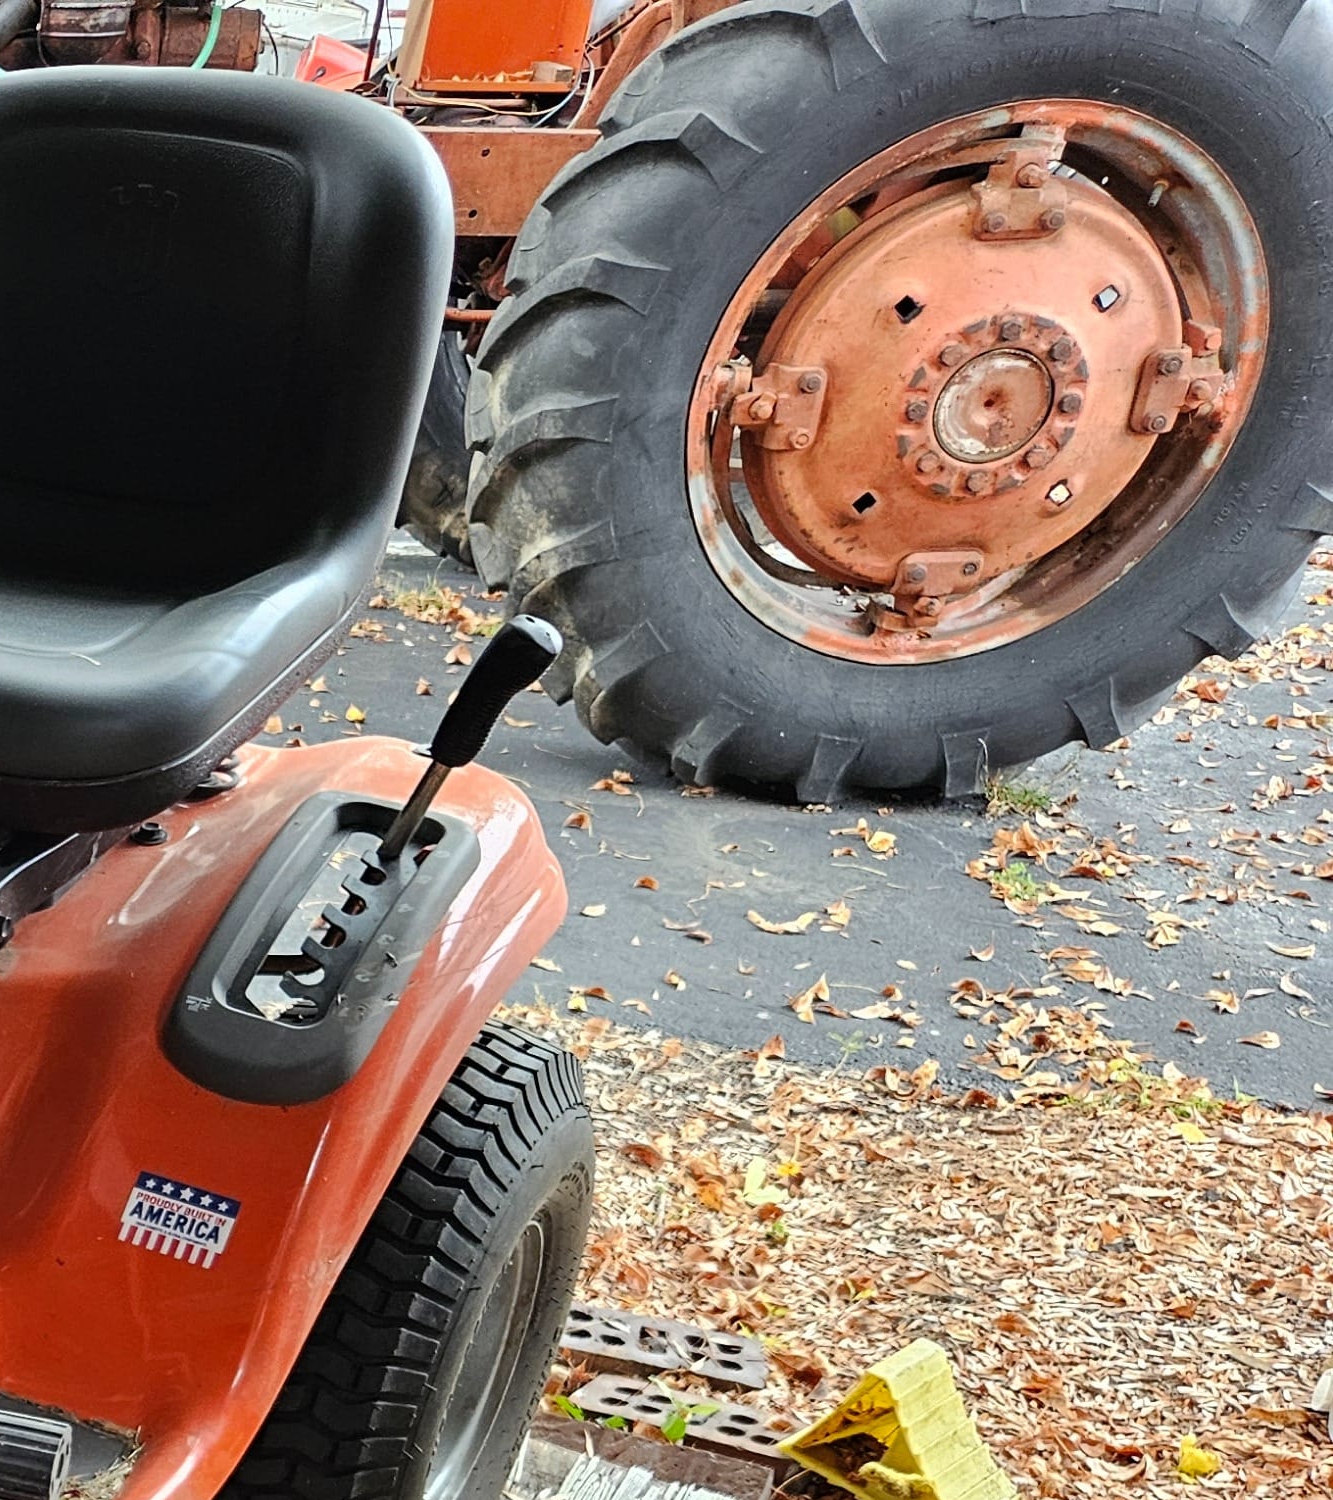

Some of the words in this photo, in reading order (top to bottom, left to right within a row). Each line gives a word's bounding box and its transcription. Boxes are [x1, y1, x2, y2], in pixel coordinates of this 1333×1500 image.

[129, 1201, 220, 1244] AMERICA
[135, 1192, 184, 1214] PROUDLY
[184, 1207, 214, 1223] BUILT
[215, 1217, 227, 1228] IN
